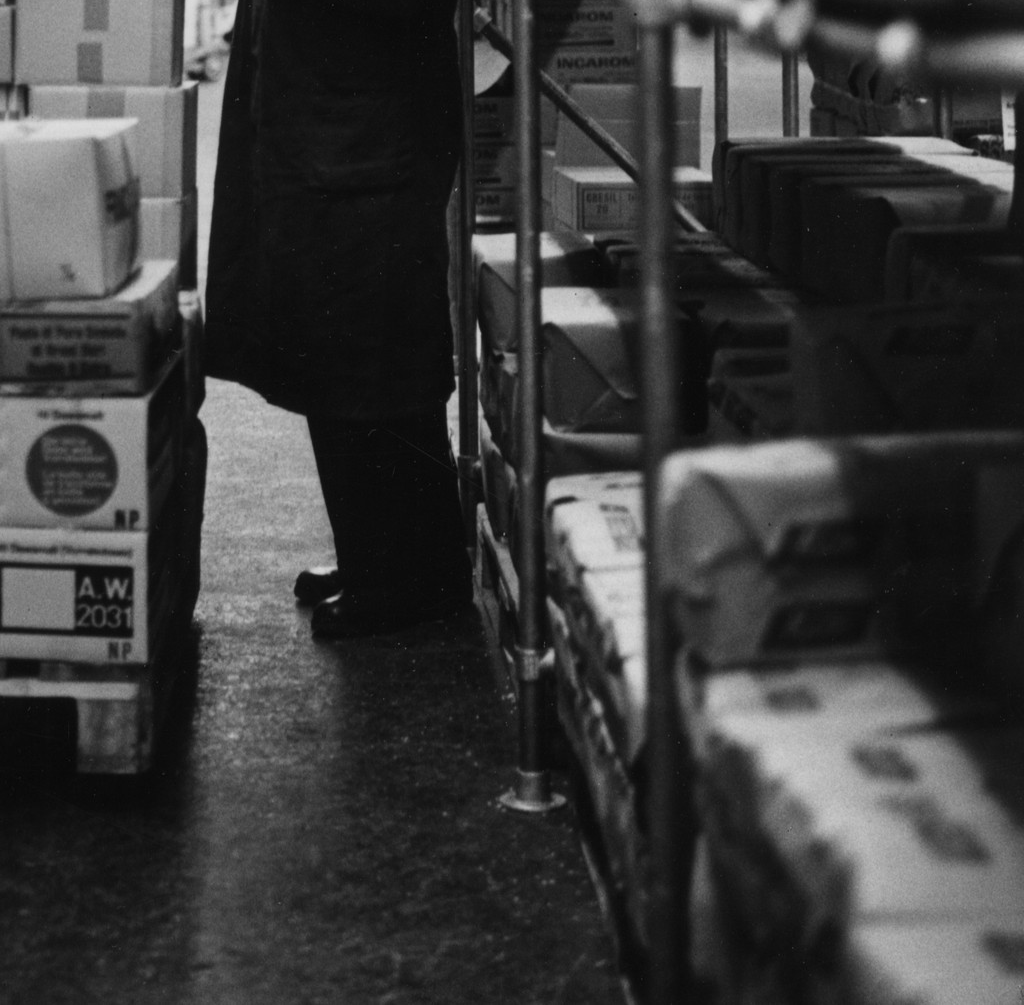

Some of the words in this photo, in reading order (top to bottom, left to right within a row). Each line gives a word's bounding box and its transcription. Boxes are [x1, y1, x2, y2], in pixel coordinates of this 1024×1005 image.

[114, 510, 139, 531] NP
[77, 605, 132, 629] 2031
[107, 642, 132, 661] NP
